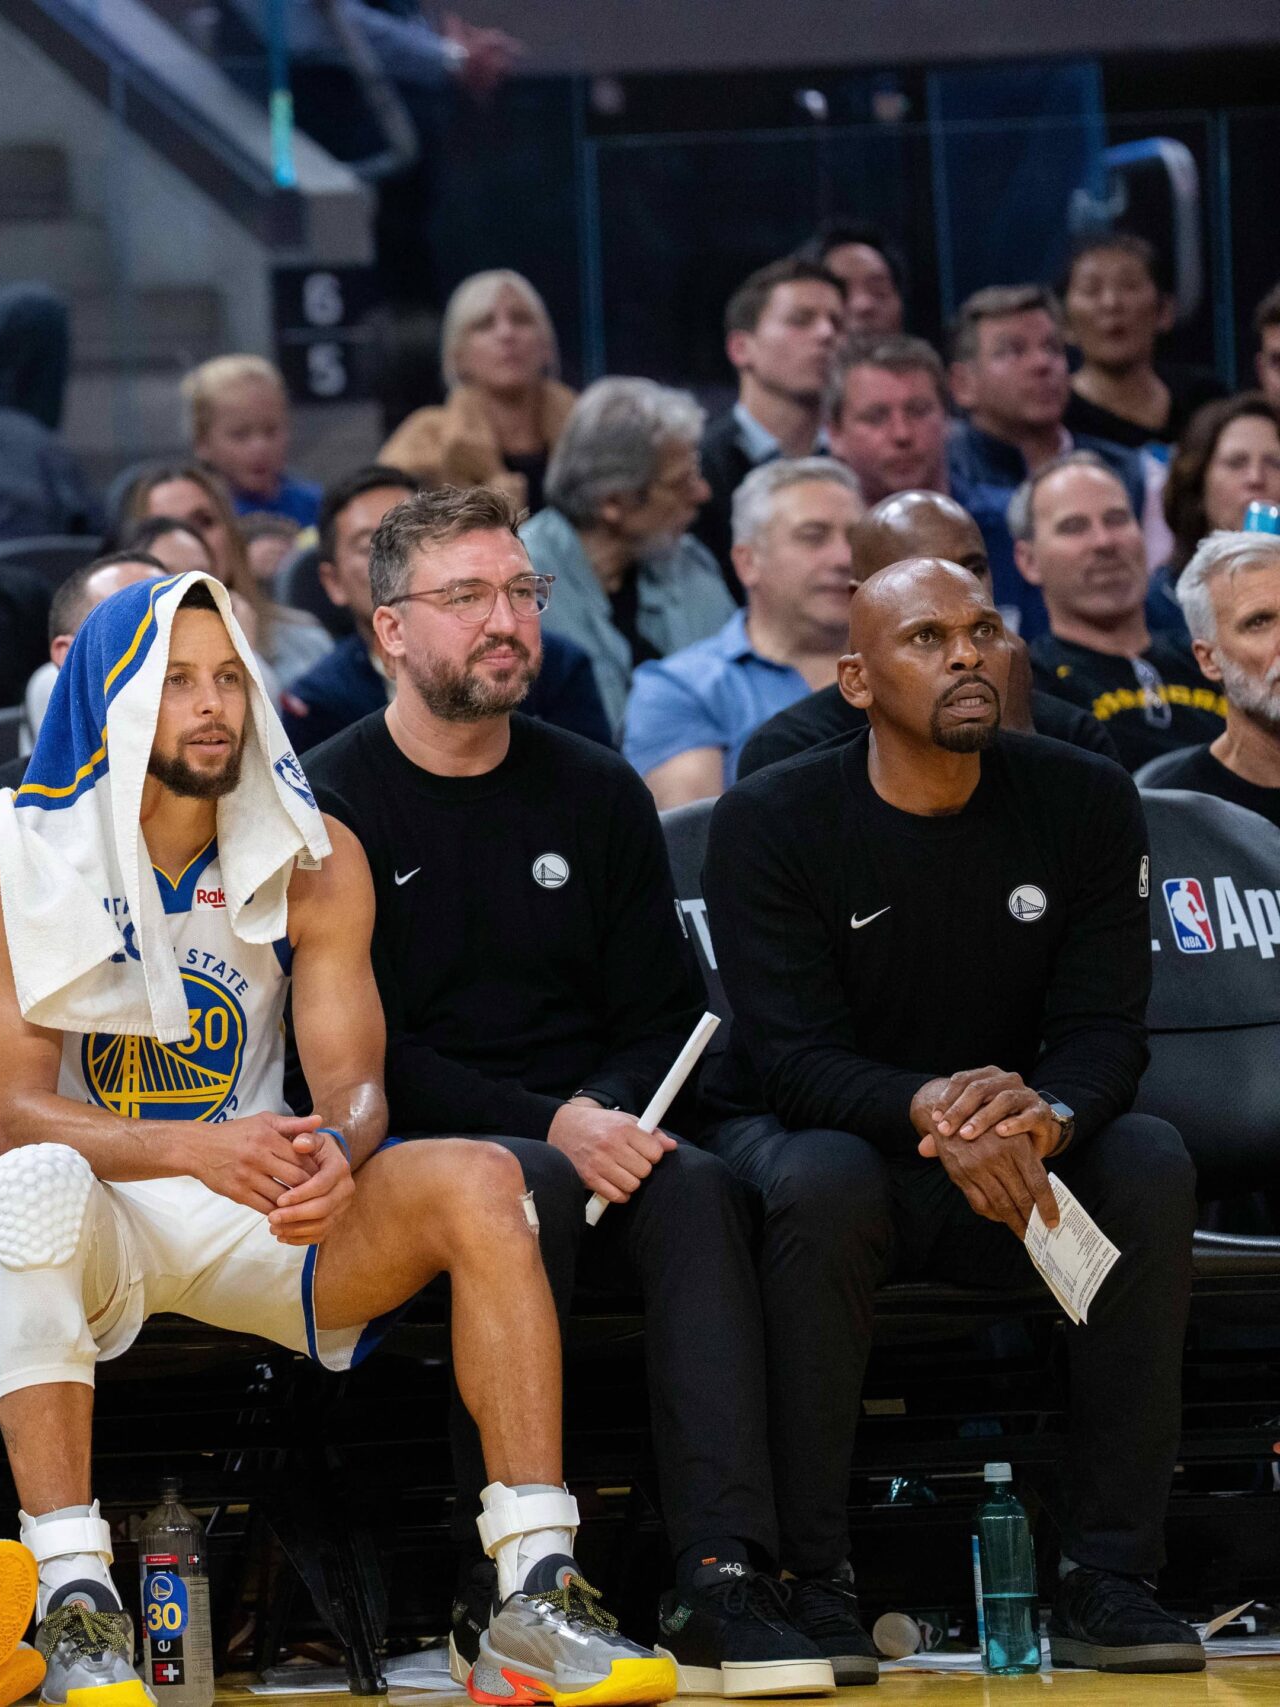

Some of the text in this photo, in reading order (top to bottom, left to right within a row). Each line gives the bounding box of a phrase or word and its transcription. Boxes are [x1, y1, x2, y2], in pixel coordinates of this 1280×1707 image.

[306, 340, 347, 397] 5
[1182, 875, 1280, 959] NBA Ap
[186, 948, 249, 997] STATE
[176, 1006, 229, 1055] 30
[147, 1602, 182, 1631] 30
